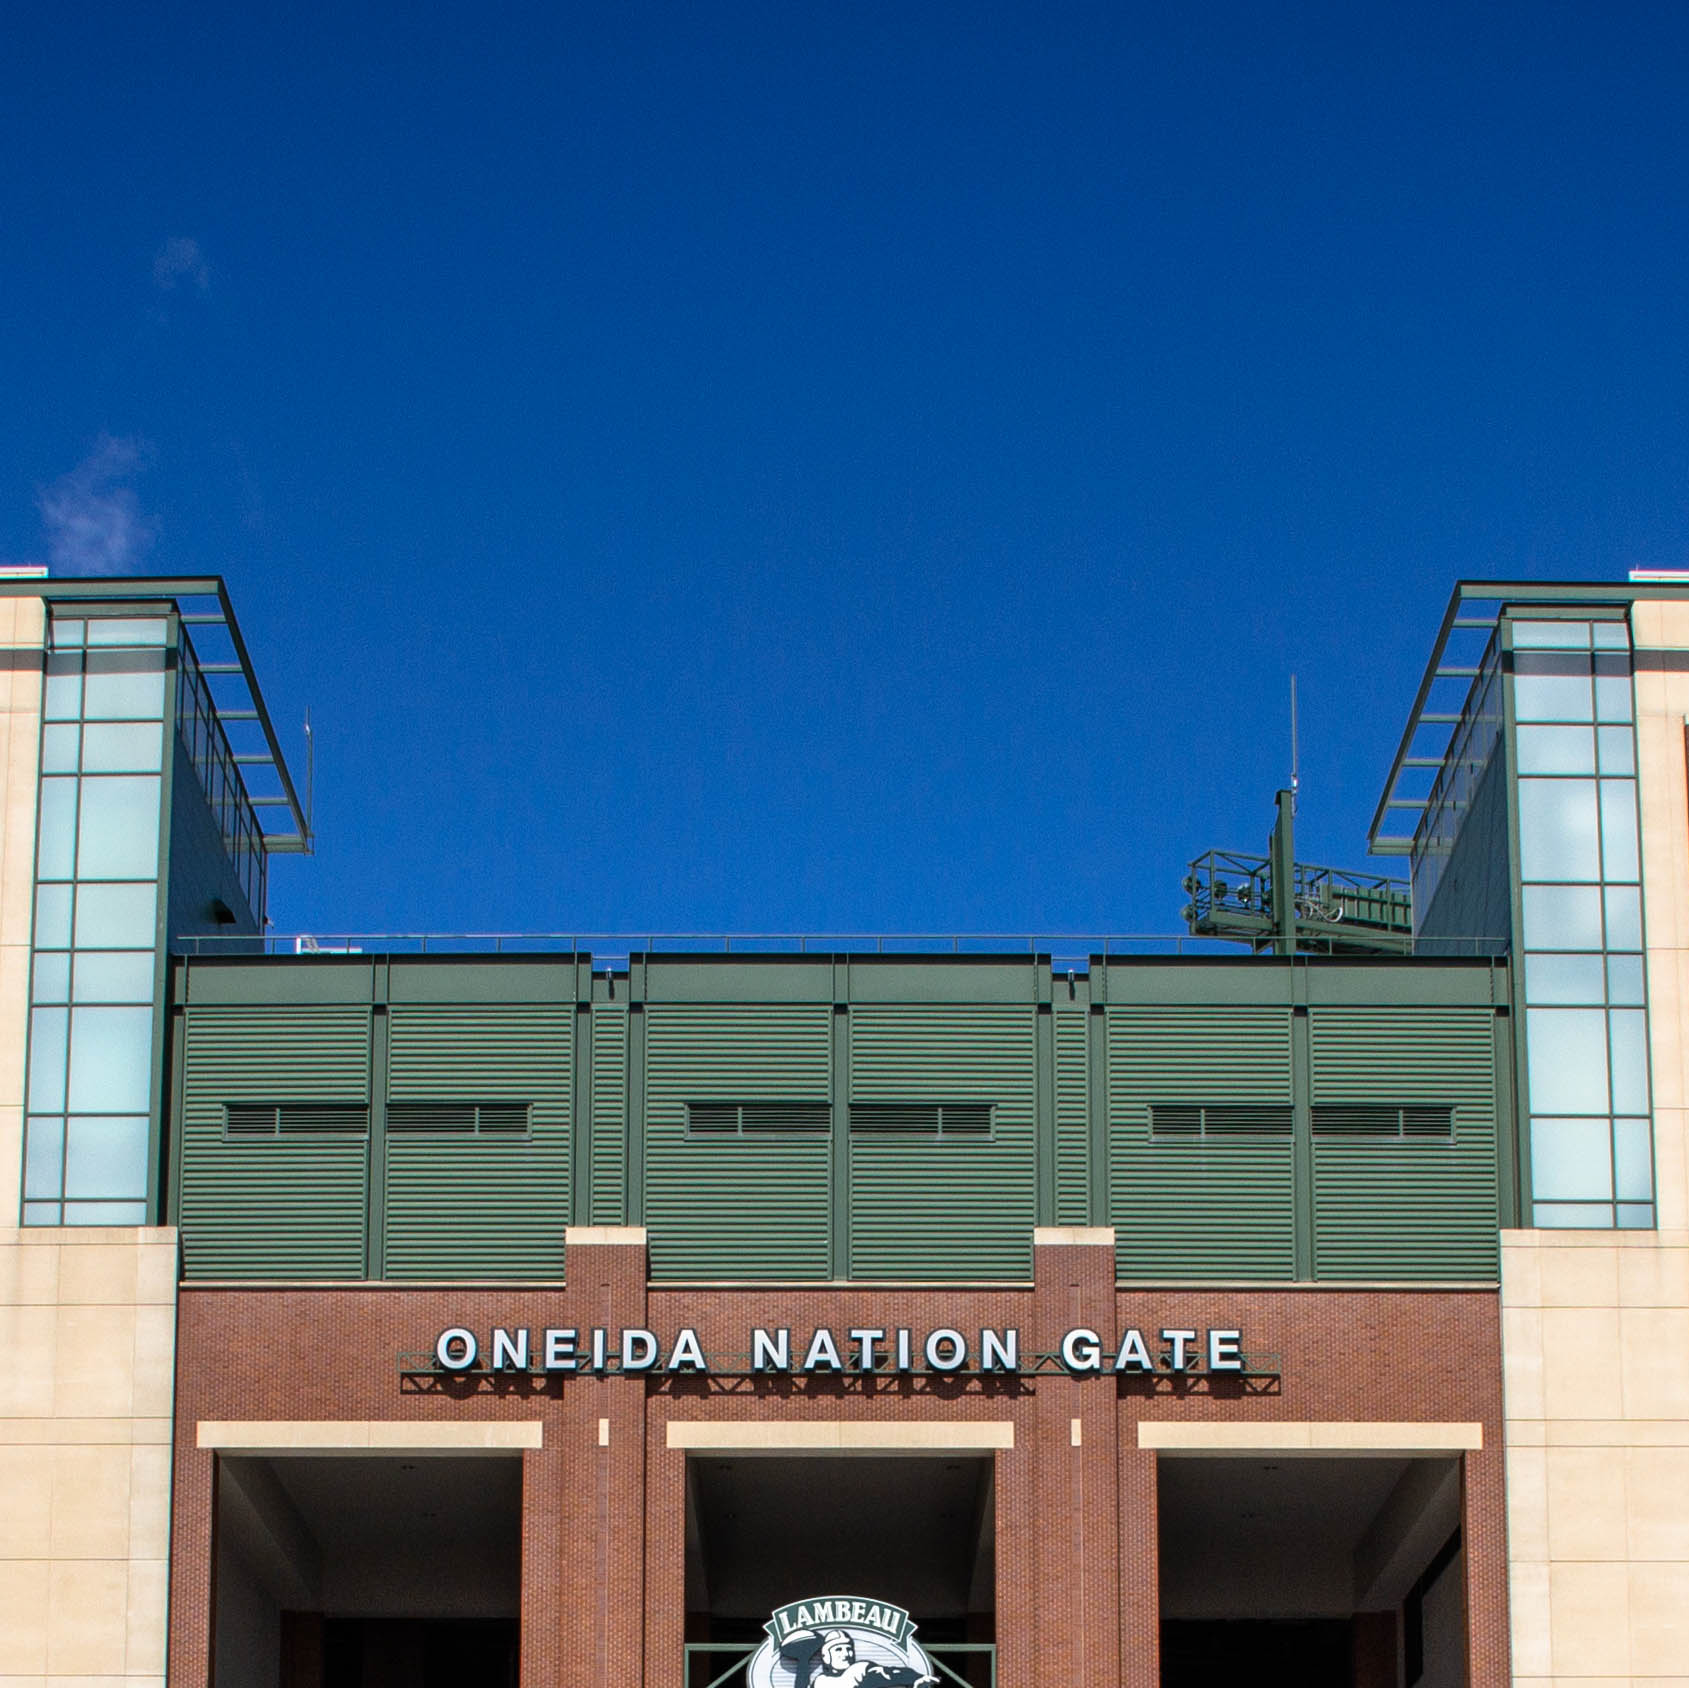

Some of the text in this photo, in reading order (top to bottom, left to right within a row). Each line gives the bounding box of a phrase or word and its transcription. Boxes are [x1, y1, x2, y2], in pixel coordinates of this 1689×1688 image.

[436, 1328, 1245, 1372] ONEIDA NATION GATE
[778, 1600, 901, 1634] LAMBEAU
